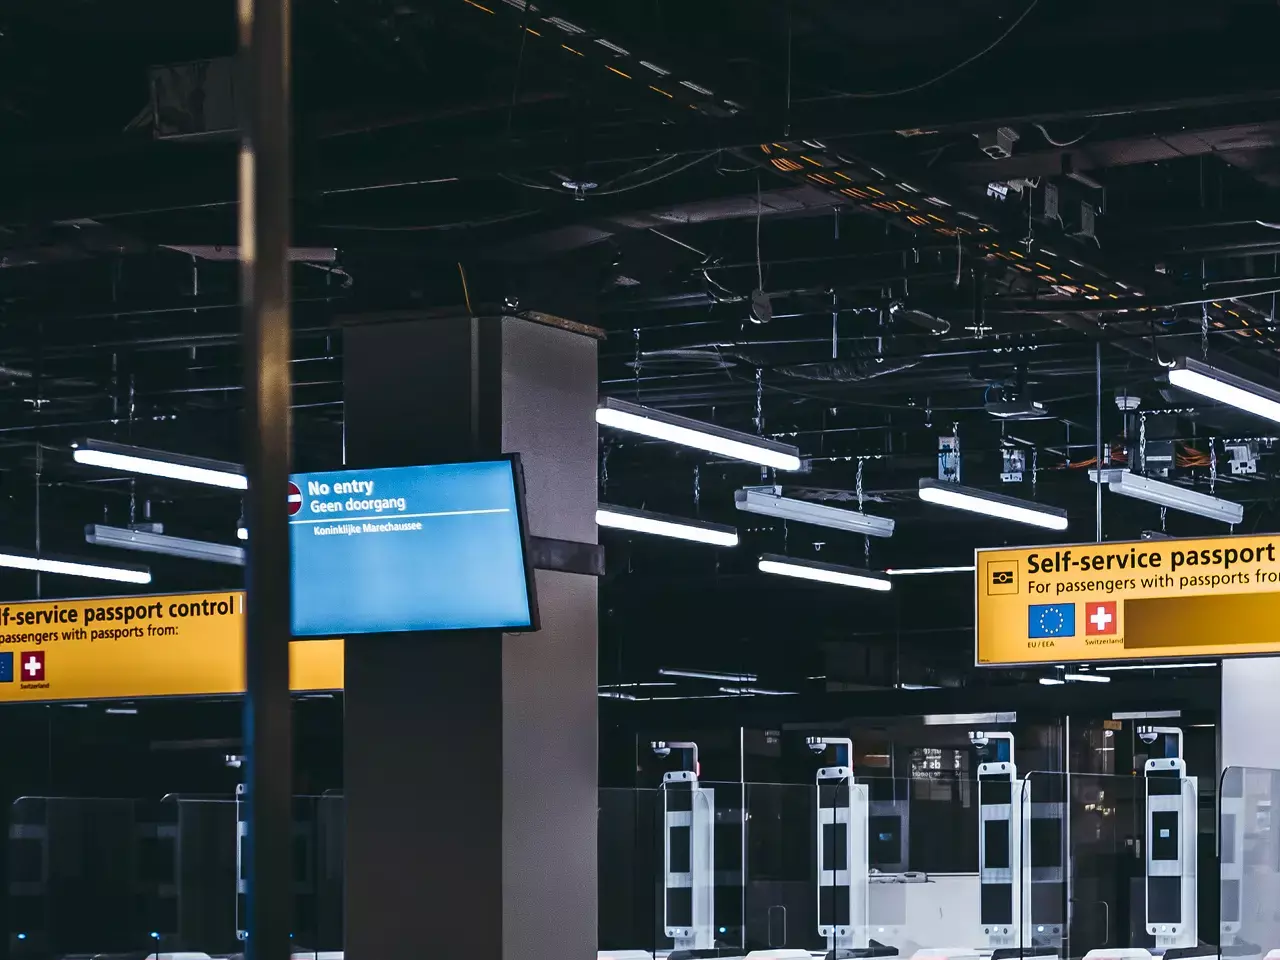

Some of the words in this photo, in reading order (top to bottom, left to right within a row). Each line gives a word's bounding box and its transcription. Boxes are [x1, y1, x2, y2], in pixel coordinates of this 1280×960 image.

[307, 481, 330, 496] No
[333, 479, 374, 496] entry
[310, 500, 342, 513] Geen
[345, 497, 406, 512] doorgang
[313, 524, 361, 536] Koninklijke
[362, 521, 422, 533] Marechaussee
[1027, 548, 1161, 574] Self-service
[1171, 543, 1275, 572] passport
[1028, 580, 1051, 594] For
[1056, 577, 1136, 595] passengers
[1141, 573, 1174, 588] with
[1180, 571, 1250, 589] passports
[84, 600, 163, 626] passport
[169, 596, 234, 618] control
[0, 630, 58, 645] passengers
[62, 627, 87, 641] with
[90, 625, 144, 642] passports
[147, 624, 179, 637] from:
[1085, 637, 1124, 646] Switzerland
[20, 682, 50, 690] Switzerland
